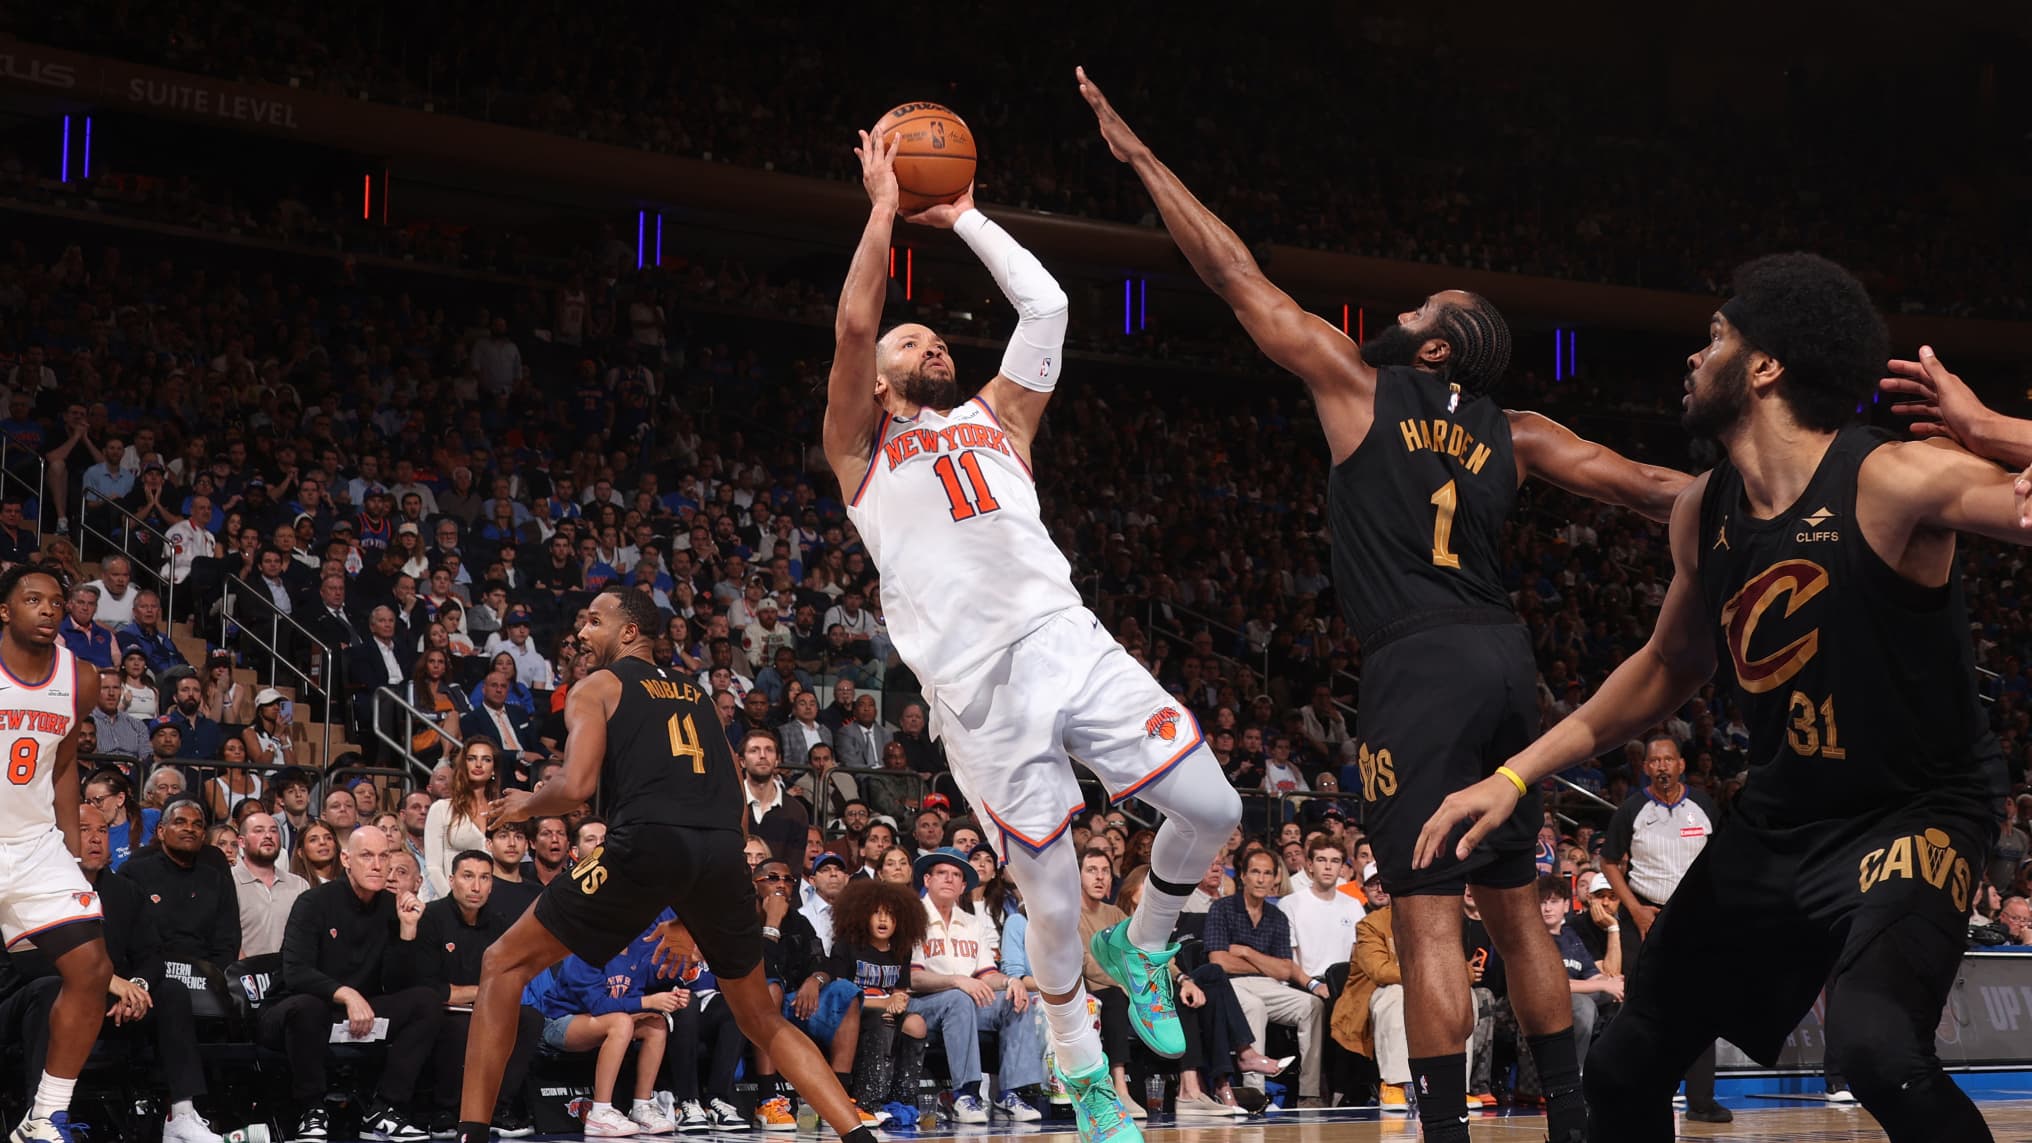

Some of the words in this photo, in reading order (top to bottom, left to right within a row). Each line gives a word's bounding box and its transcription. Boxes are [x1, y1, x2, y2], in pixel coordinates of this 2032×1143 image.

[129, 77, 208, 113] SUITE
[217, 92, 297, 128] LEVEL
[884, 428, 939, 472] NEW
[940, 423, 1010, 457] YORK
[1400, 418, 1492, 475] HARDEN
[933, 449, 1001, 522] 11
[1430, 478, 1461, 569] 1
[1796, 531, 1839, 543] CLIFFS
[640, 679, 702, 704] MOBLEY
[26, 710, 71, 736] YORK
[668, 712, 706, 774] 4
[1787, 690, 1846, 760] 31
[7, 737, 40, 785] 8
[1859, 828, 1971, 912] CAVS
[165, 961, 192, 977] STERN
[1980, 986, 2021, 1031] UP
